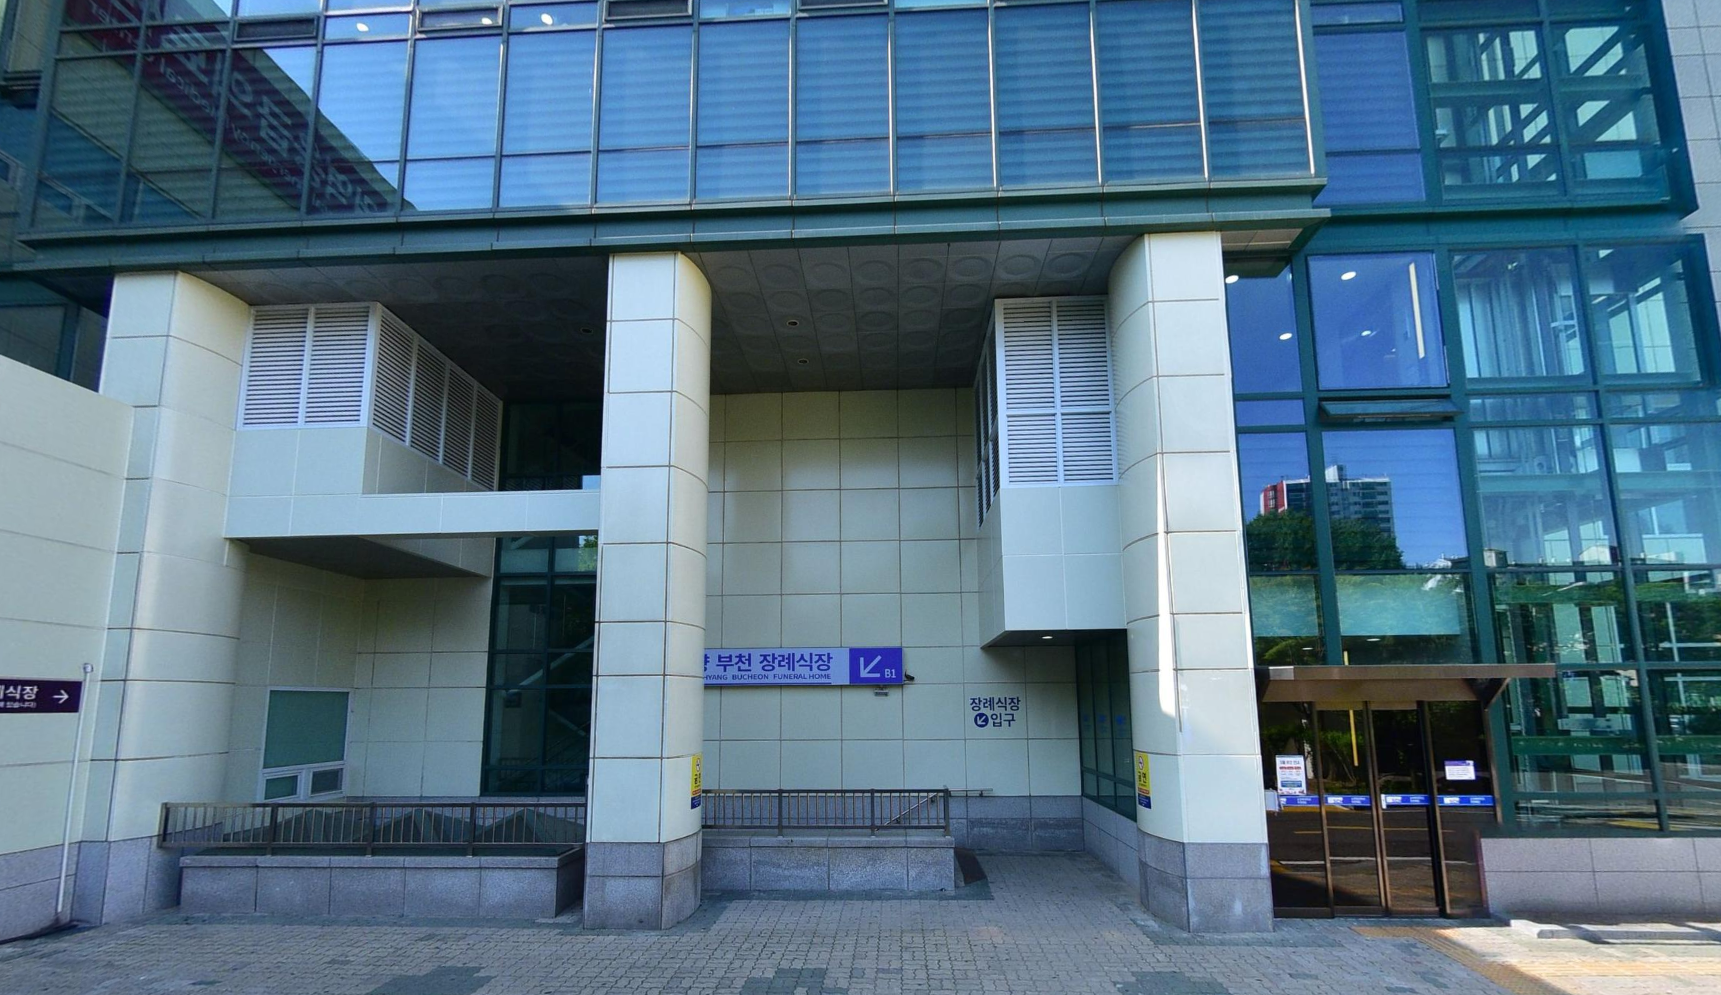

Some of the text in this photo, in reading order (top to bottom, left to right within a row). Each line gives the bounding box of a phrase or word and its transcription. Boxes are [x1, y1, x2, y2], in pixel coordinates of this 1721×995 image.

[716, 652, 752, 673] 부천
[759, 652, 833, 672] 장례식장
[732, 673, 769, 681] BUCHEON
[884, 668, 896, 678] B1
[970, 696, 1021, 711] 장례식장
[990, 713, 1016, 727] 입구
